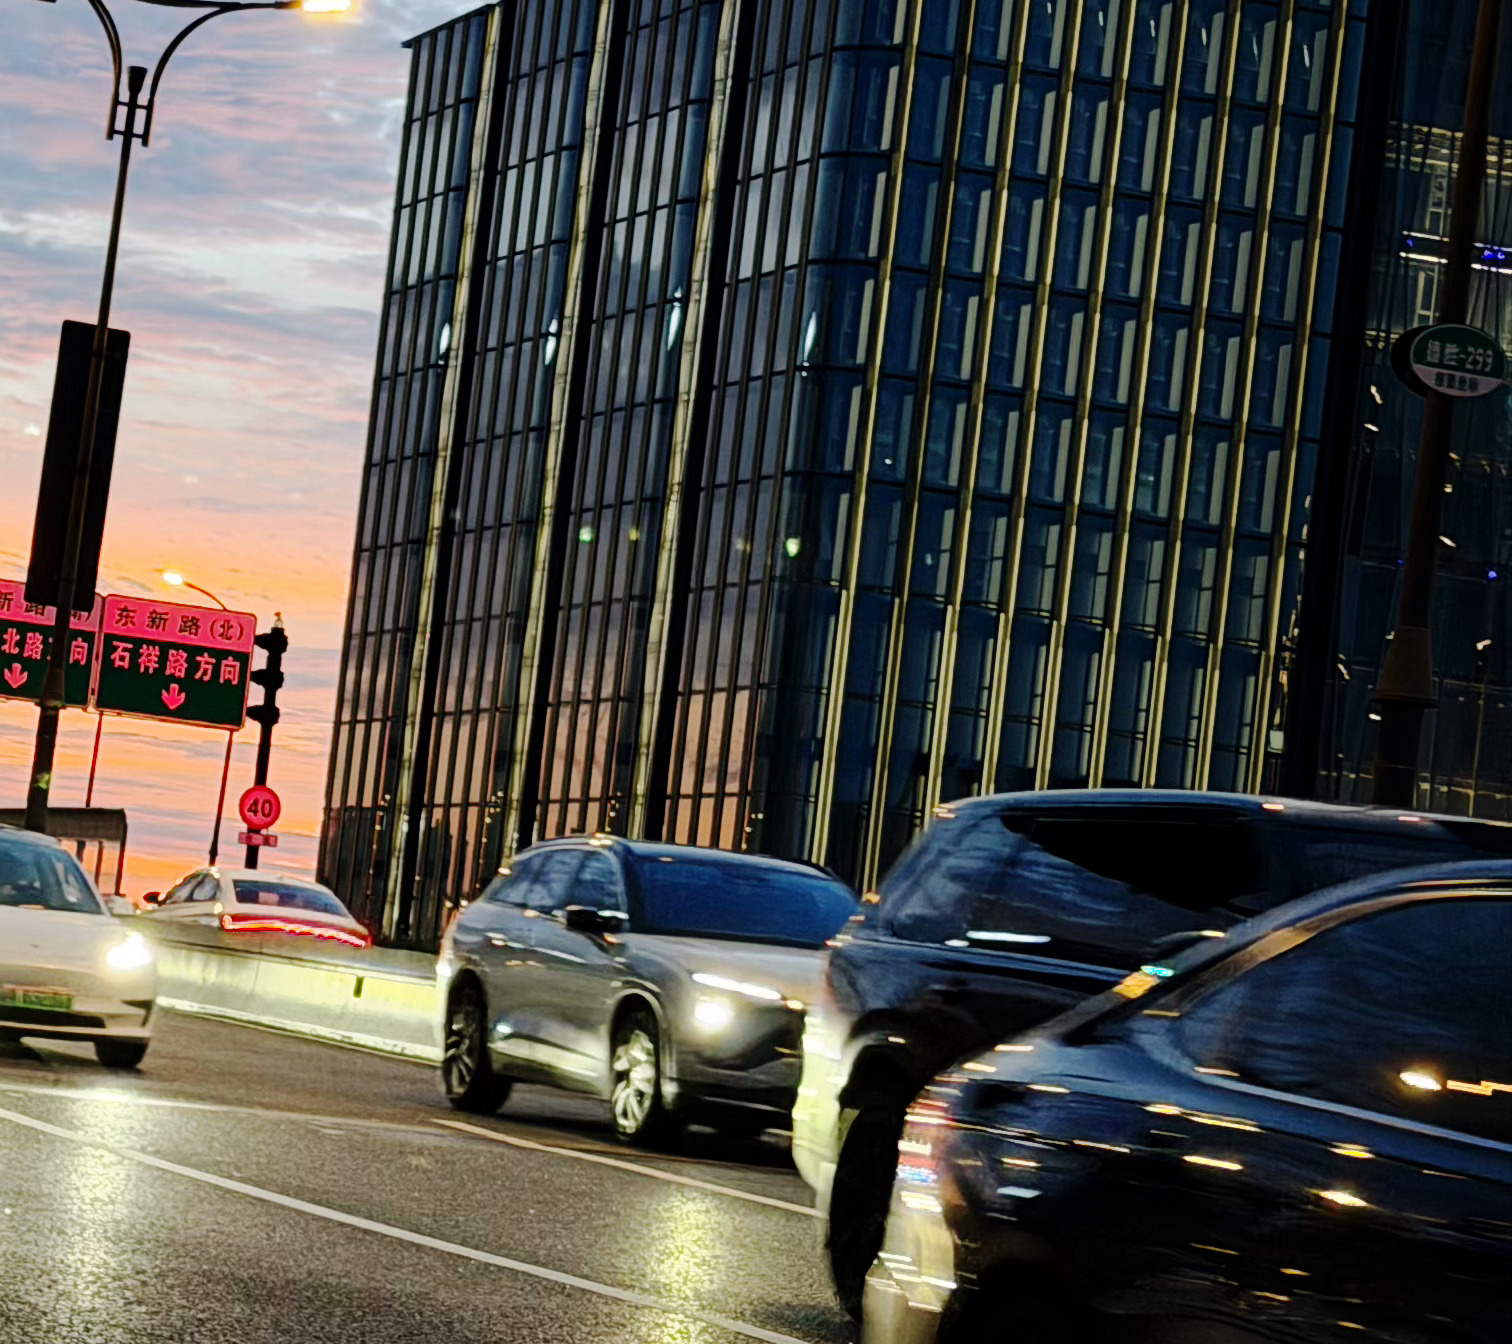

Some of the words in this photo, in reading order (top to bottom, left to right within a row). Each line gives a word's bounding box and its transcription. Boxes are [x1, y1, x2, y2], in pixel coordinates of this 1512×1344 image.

[114, 605, 244, 641] 东新路(北)
[110, 640, 241, 686] 石祥路方向
[246, 796, 273, 819] 40
